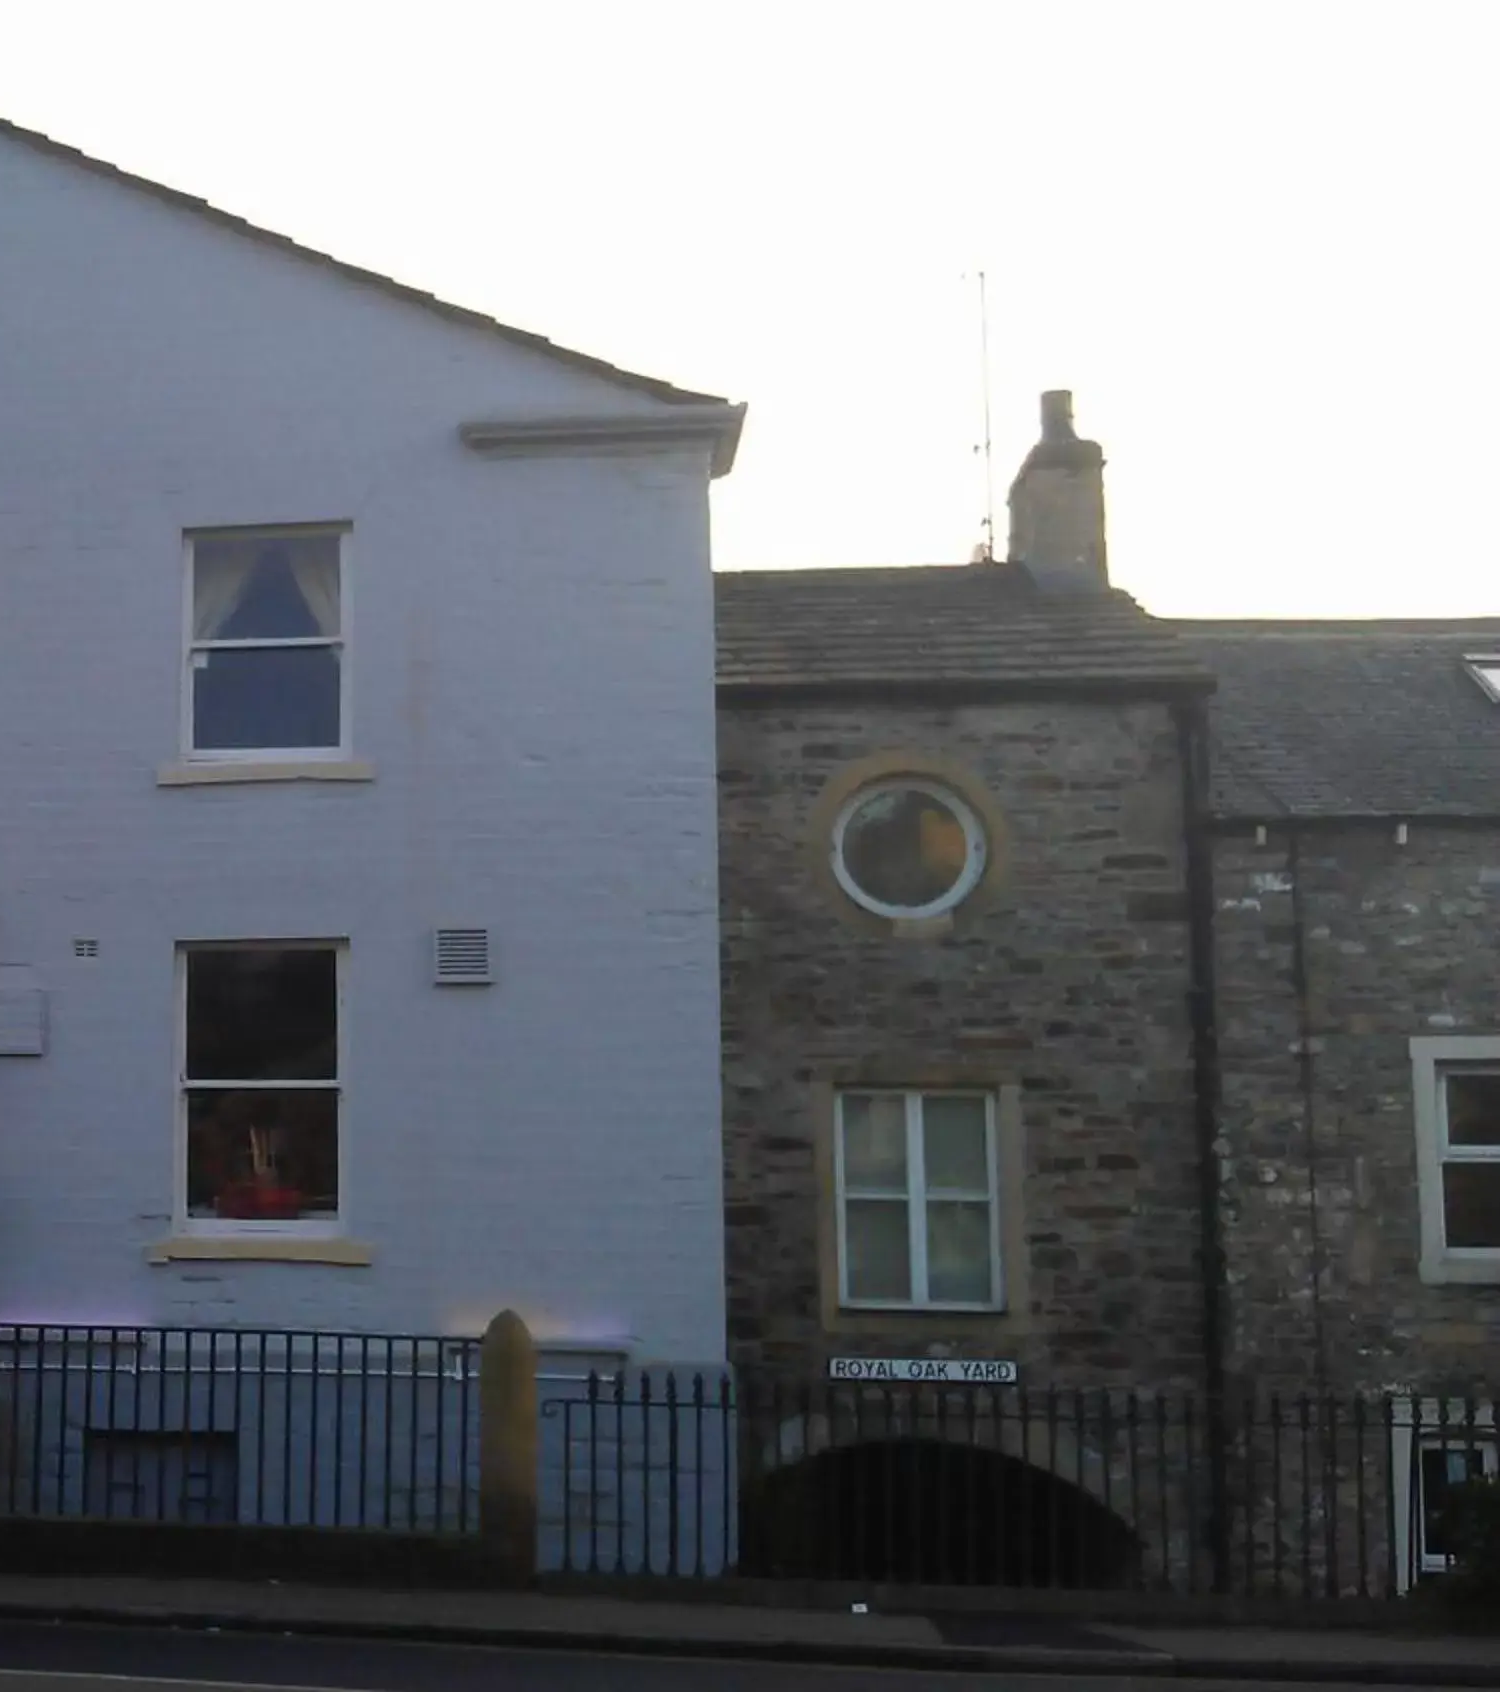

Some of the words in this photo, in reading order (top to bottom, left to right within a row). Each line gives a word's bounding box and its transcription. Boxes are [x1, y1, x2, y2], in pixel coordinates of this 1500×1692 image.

[835, 1360, 899, 1378] ROYAL
[908, 1361, 949, 1379] OAK
[961, 1362, 1012, 1380] YARD
